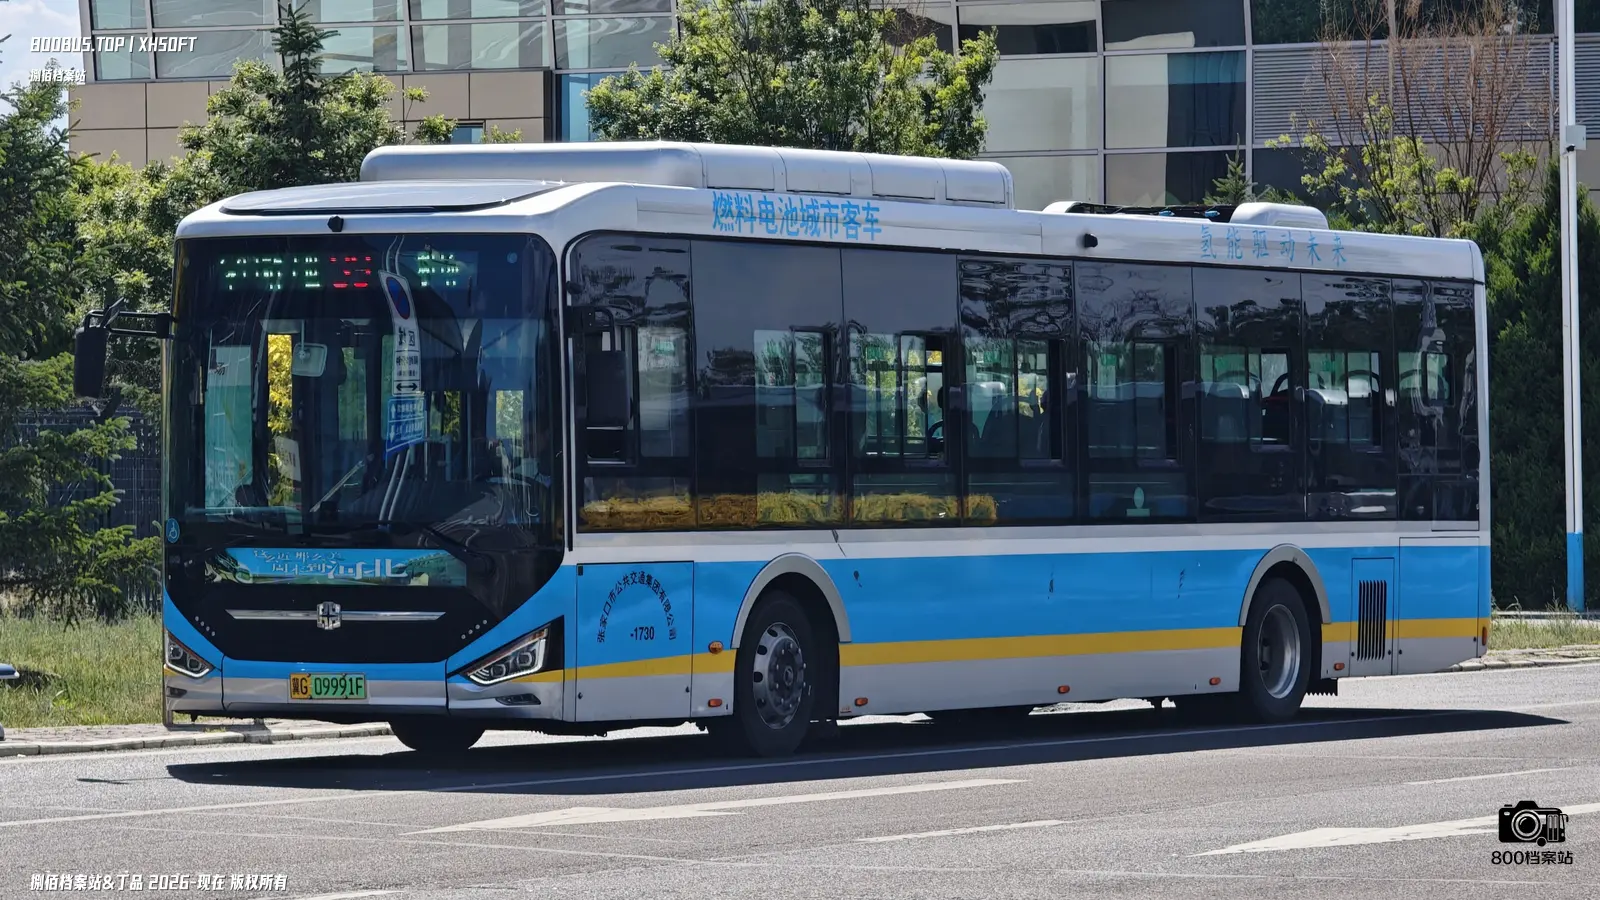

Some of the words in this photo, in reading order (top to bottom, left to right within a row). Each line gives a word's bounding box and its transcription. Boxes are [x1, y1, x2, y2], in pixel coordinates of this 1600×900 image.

[712, 190, 882, 241] 燃料电池城市客车
[1200, 224, 1348, 267] 氢能驱动未来
[596, 570, 677, 643] 张家口市公共交通集团有限公司
